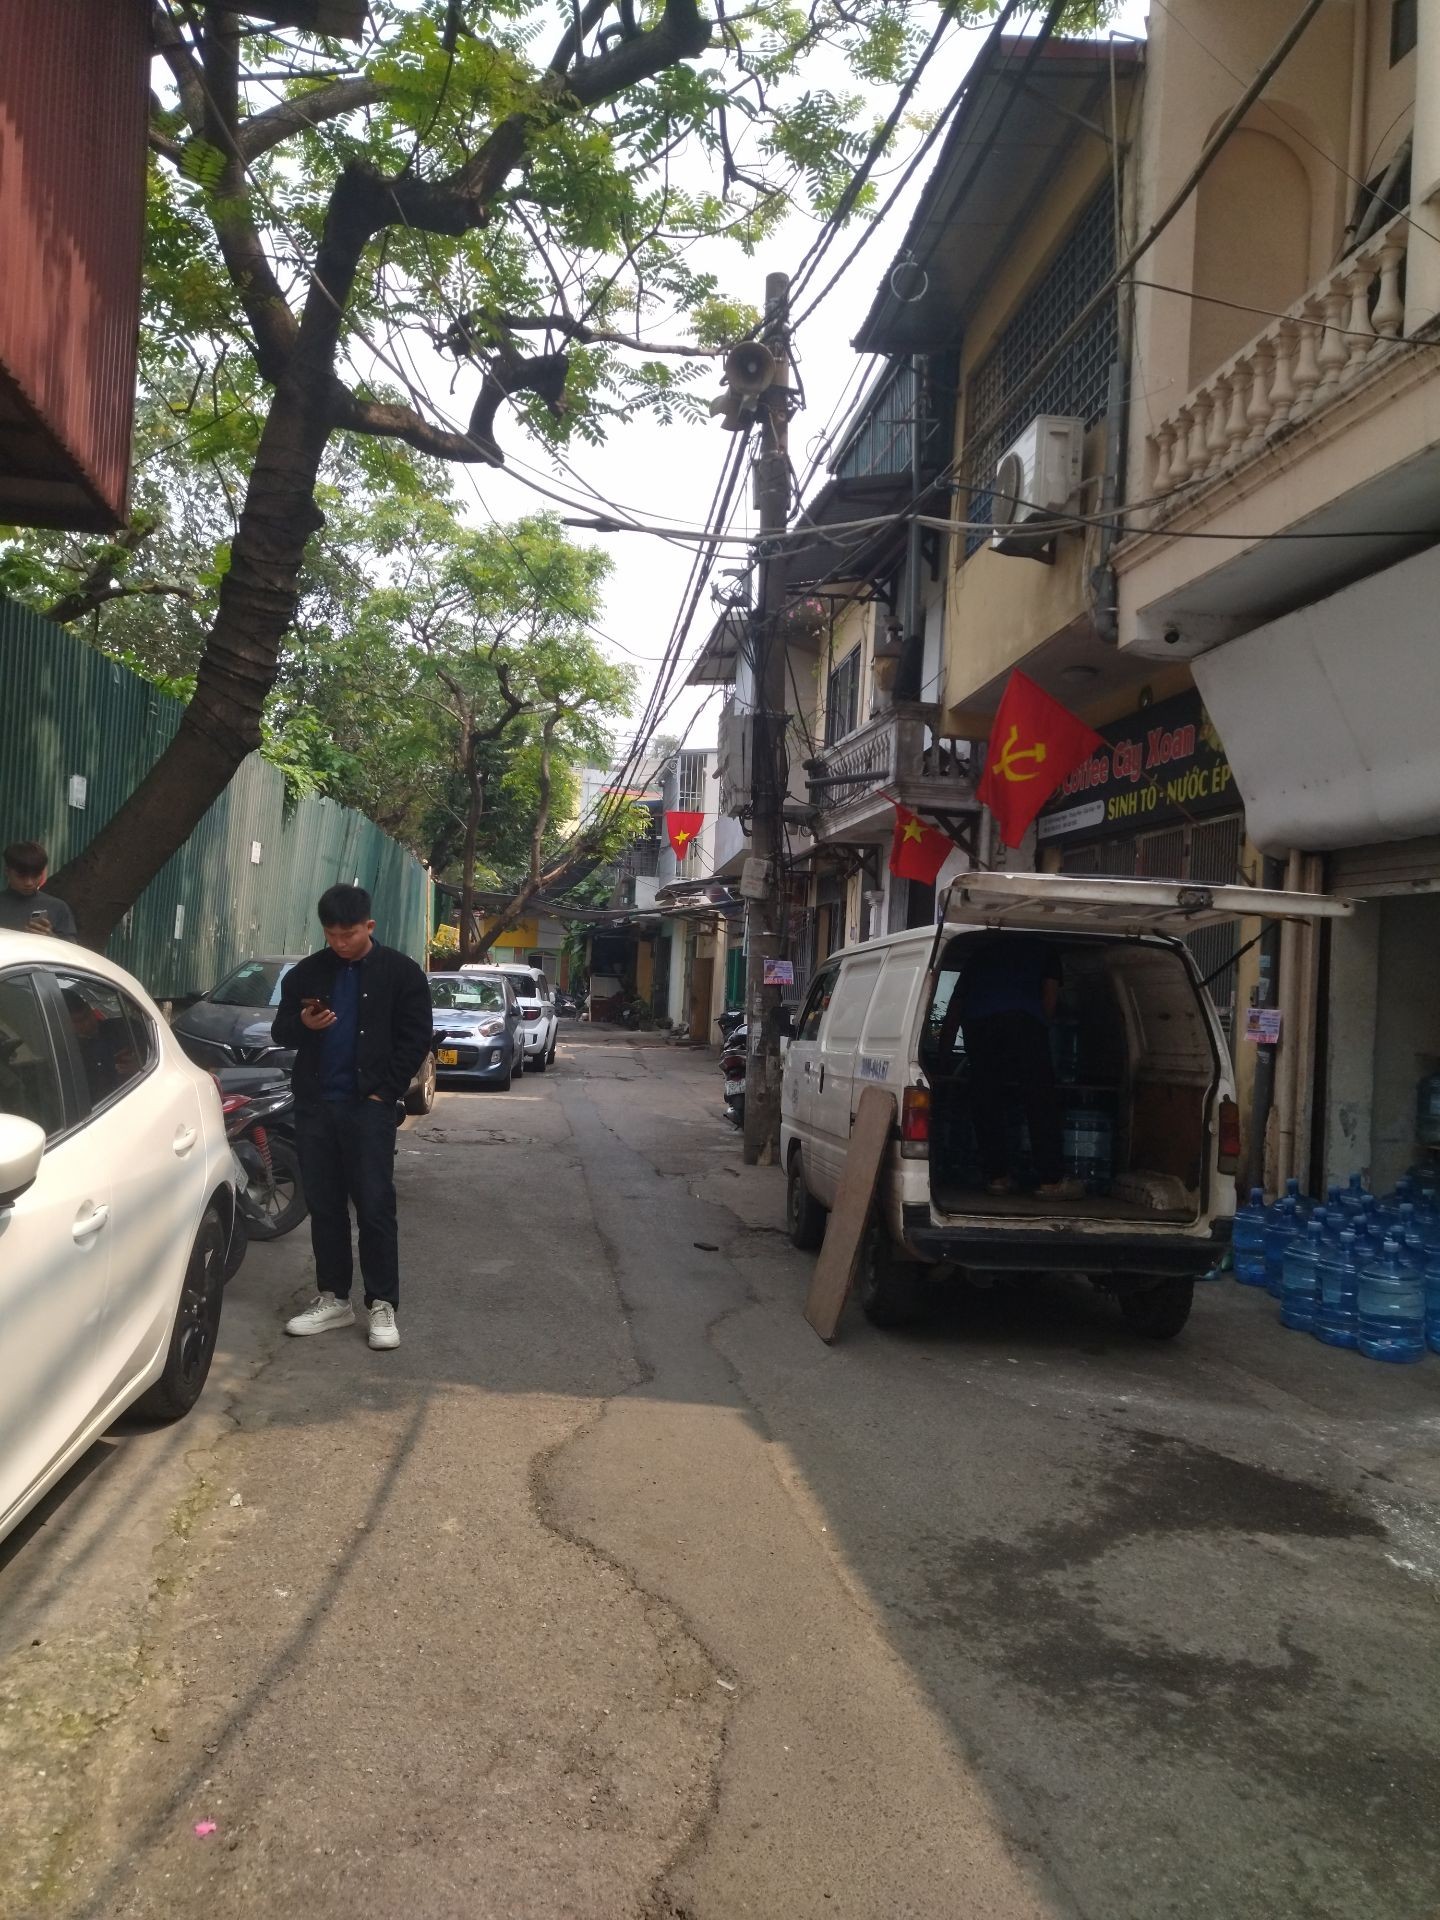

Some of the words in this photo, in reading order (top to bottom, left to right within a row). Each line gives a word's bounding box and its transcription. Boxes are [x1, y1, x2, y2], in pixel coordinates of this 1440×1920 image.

[1146, 724, 1196, 769] Xoan
[1107, 791, 1137, 821] SINH
[1211, 758, 1233, 794] ÉP
